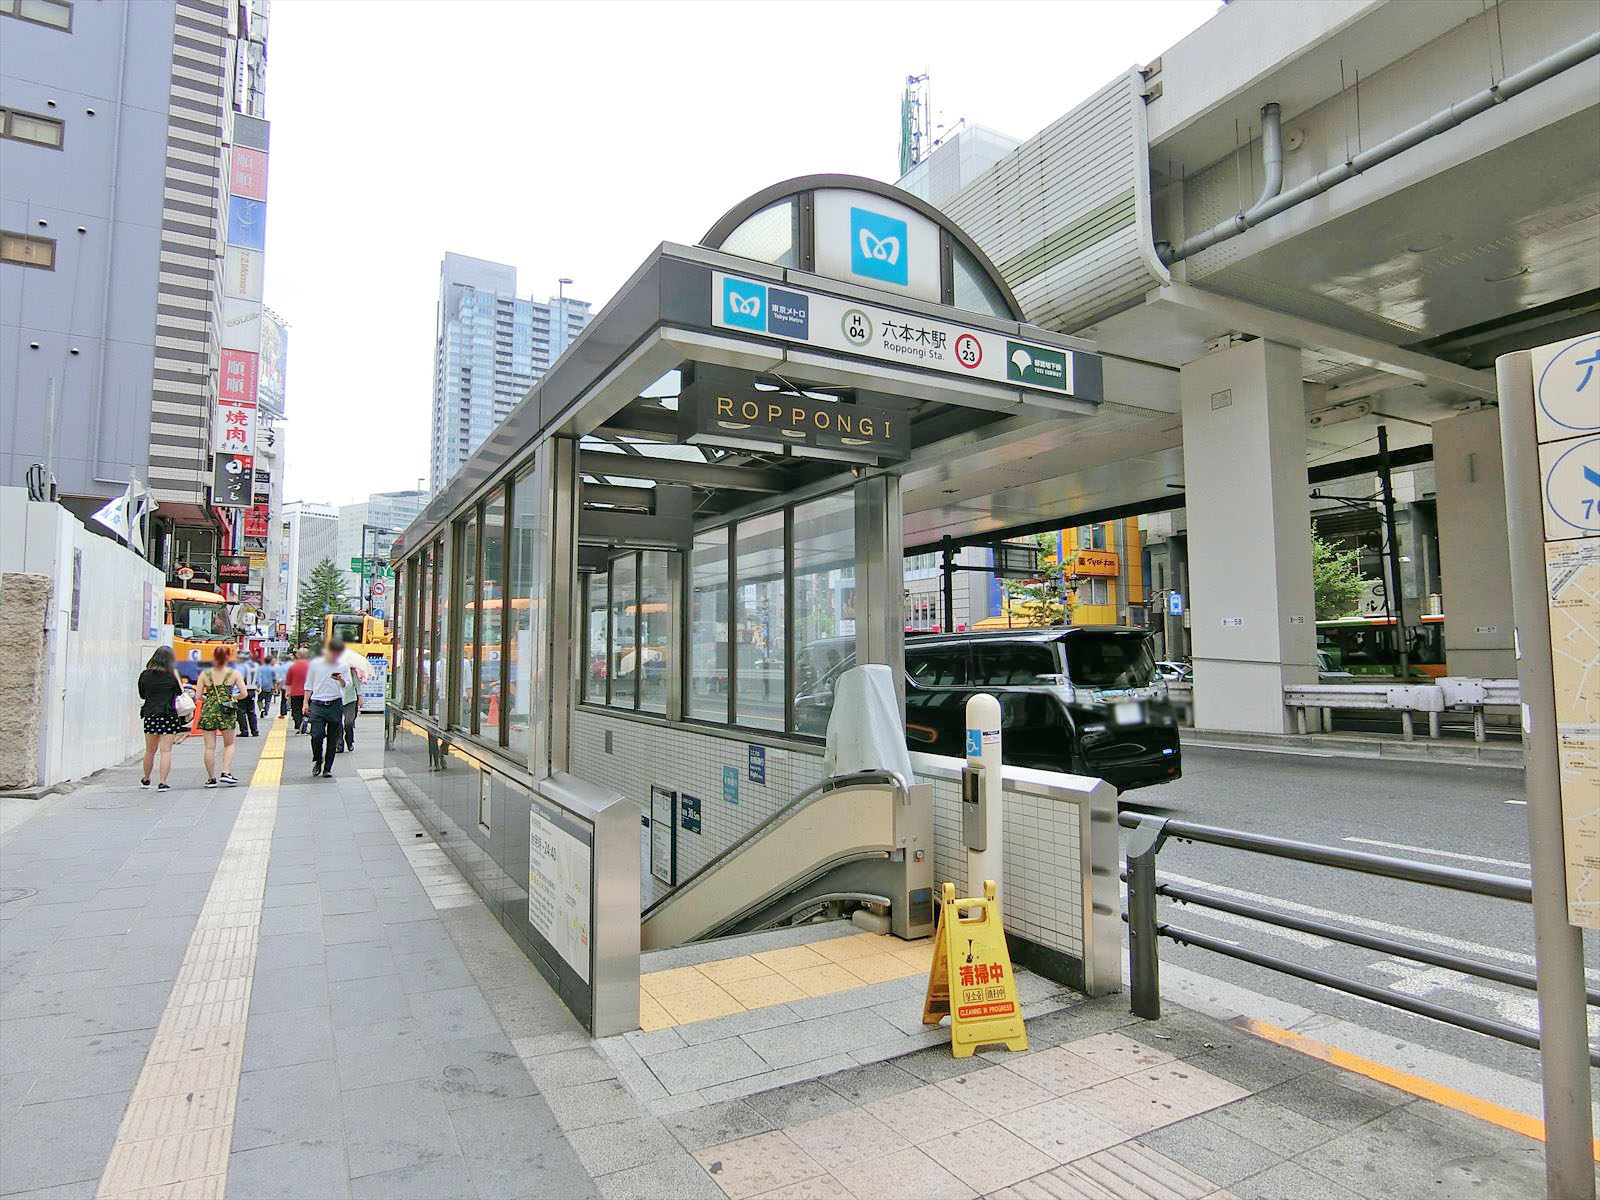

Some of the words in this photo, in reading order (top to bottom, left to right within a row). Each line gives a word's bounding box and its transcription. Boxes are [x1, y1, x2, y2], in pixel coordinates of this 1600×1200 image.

[771, 304, 806, 318] 東京メトロ
[773, 312, 788, 321] Tokyo
[788, 316, 804, 324] Metro
[852, 315, 862, 327] H
[849, 326, 866, 340] 04
[881, 320, 947, 351] 六本木駅
[883, 340, 927, 359] Roppongi
[928, 349, 946, 361] Sta.
[965, 340, 972, 350] E
[962, 350, 976, 362] 23
[716, 396, 892, 439] ROPPONGI
[225, 410, 249, 444] 焼肉
[959, 962, 1004, 987] 清掃中
[960, 1007, 983, 1017] CLEANING
[989, 1004, 1013, 1013] PROGRESS
